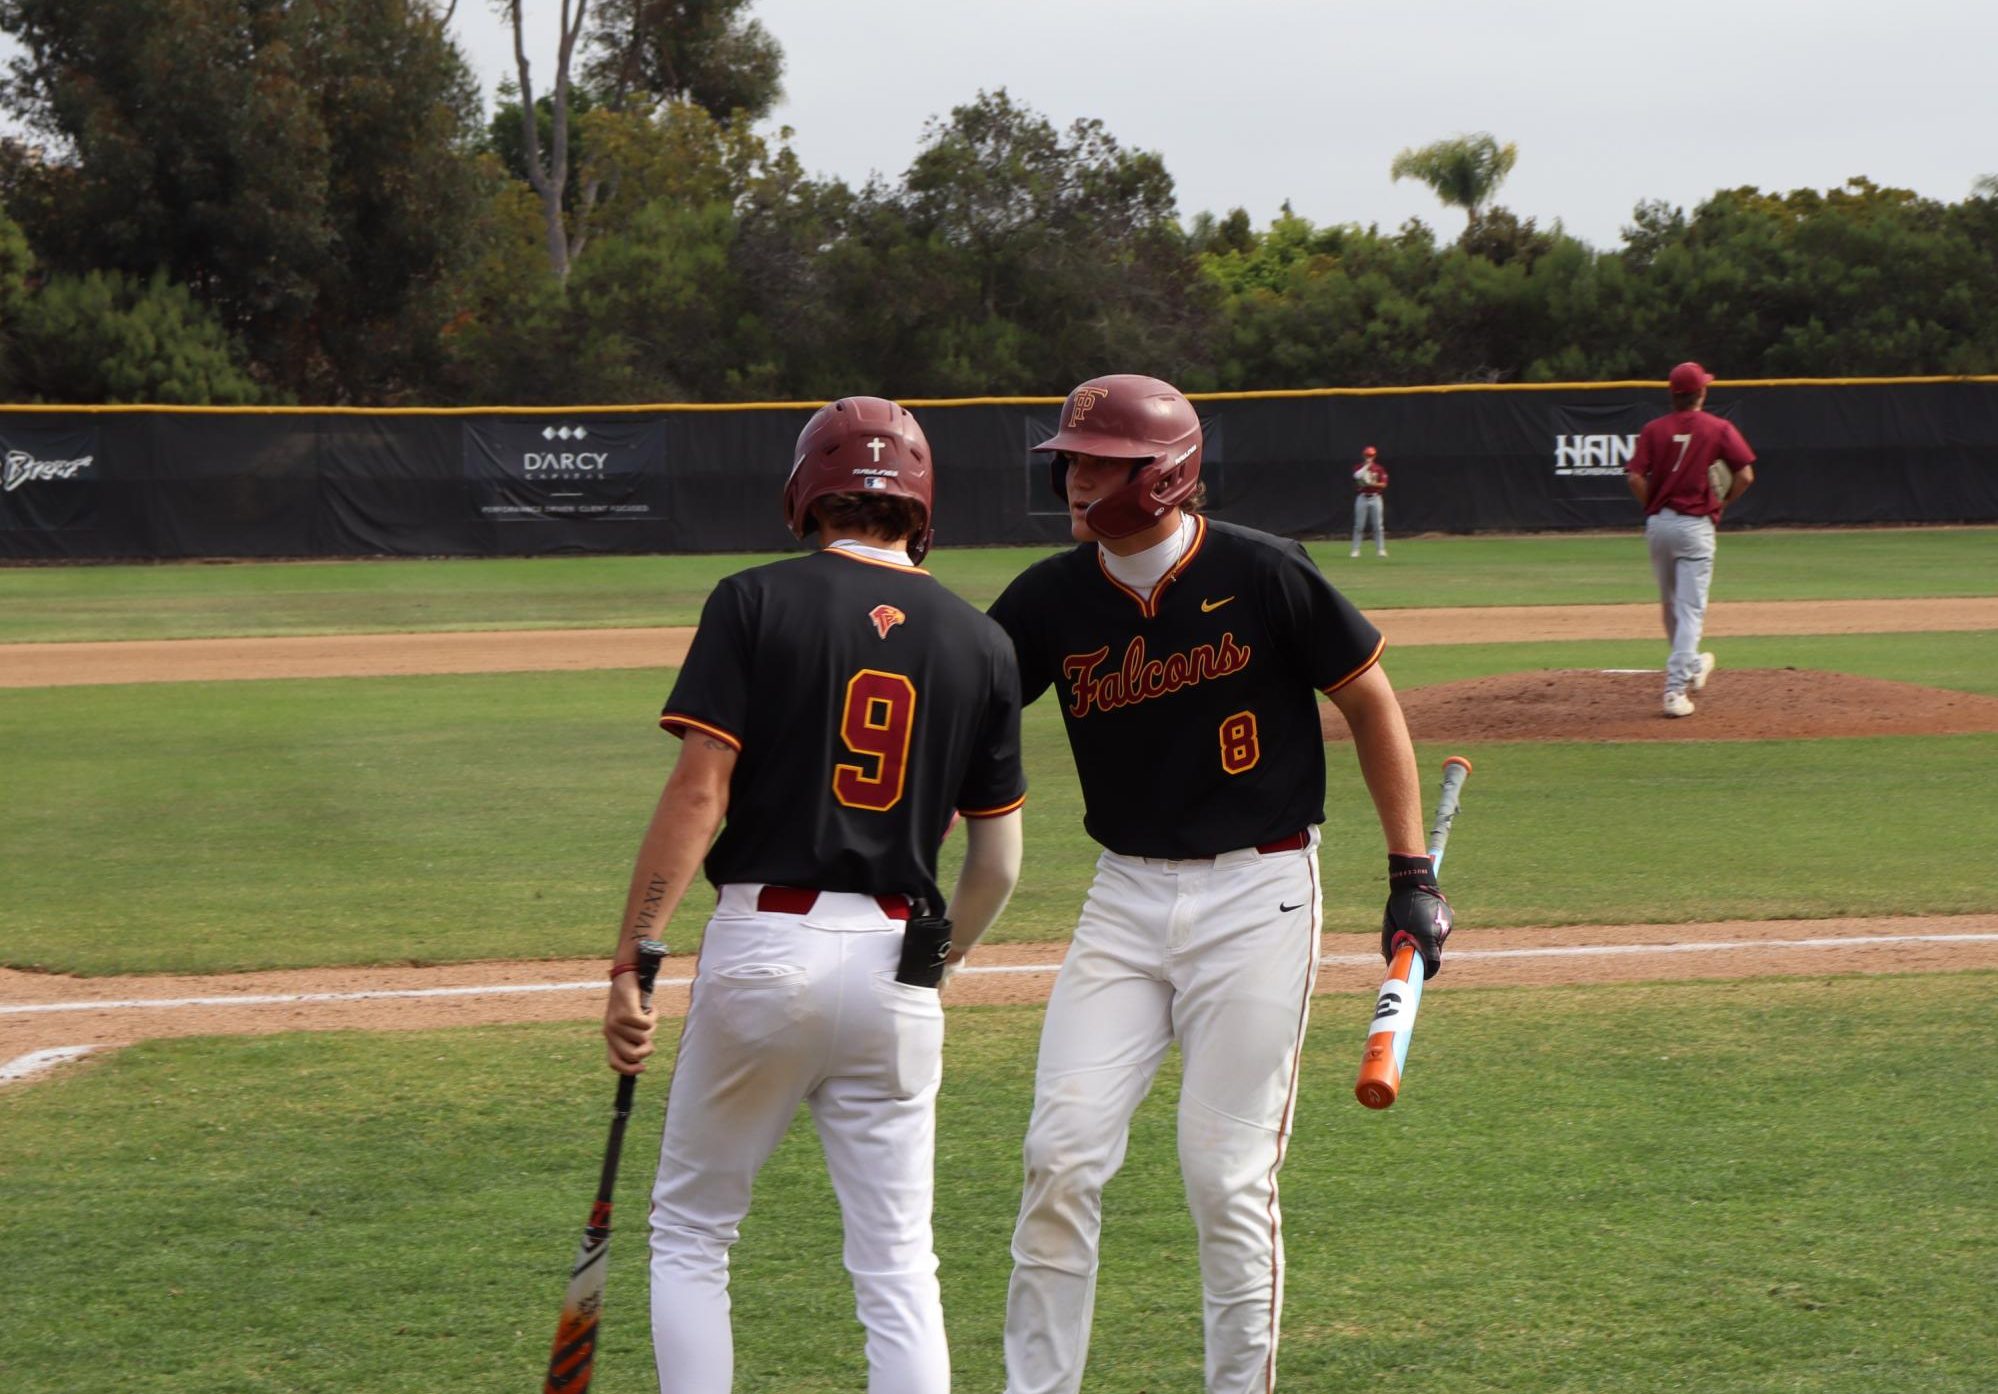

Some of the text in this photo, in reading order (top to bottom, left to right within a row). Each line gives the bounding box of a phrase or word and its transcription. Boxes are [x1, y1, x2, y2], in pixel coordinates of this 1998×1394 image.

[523, 452, 609, 470] D'ARCY
[1672, 433, 1692, 472] 7
[1063, 632, 1251, 718] Falcons
[832, 668, 917, 812] 9
[1219, 710, 1260, 775] 8
